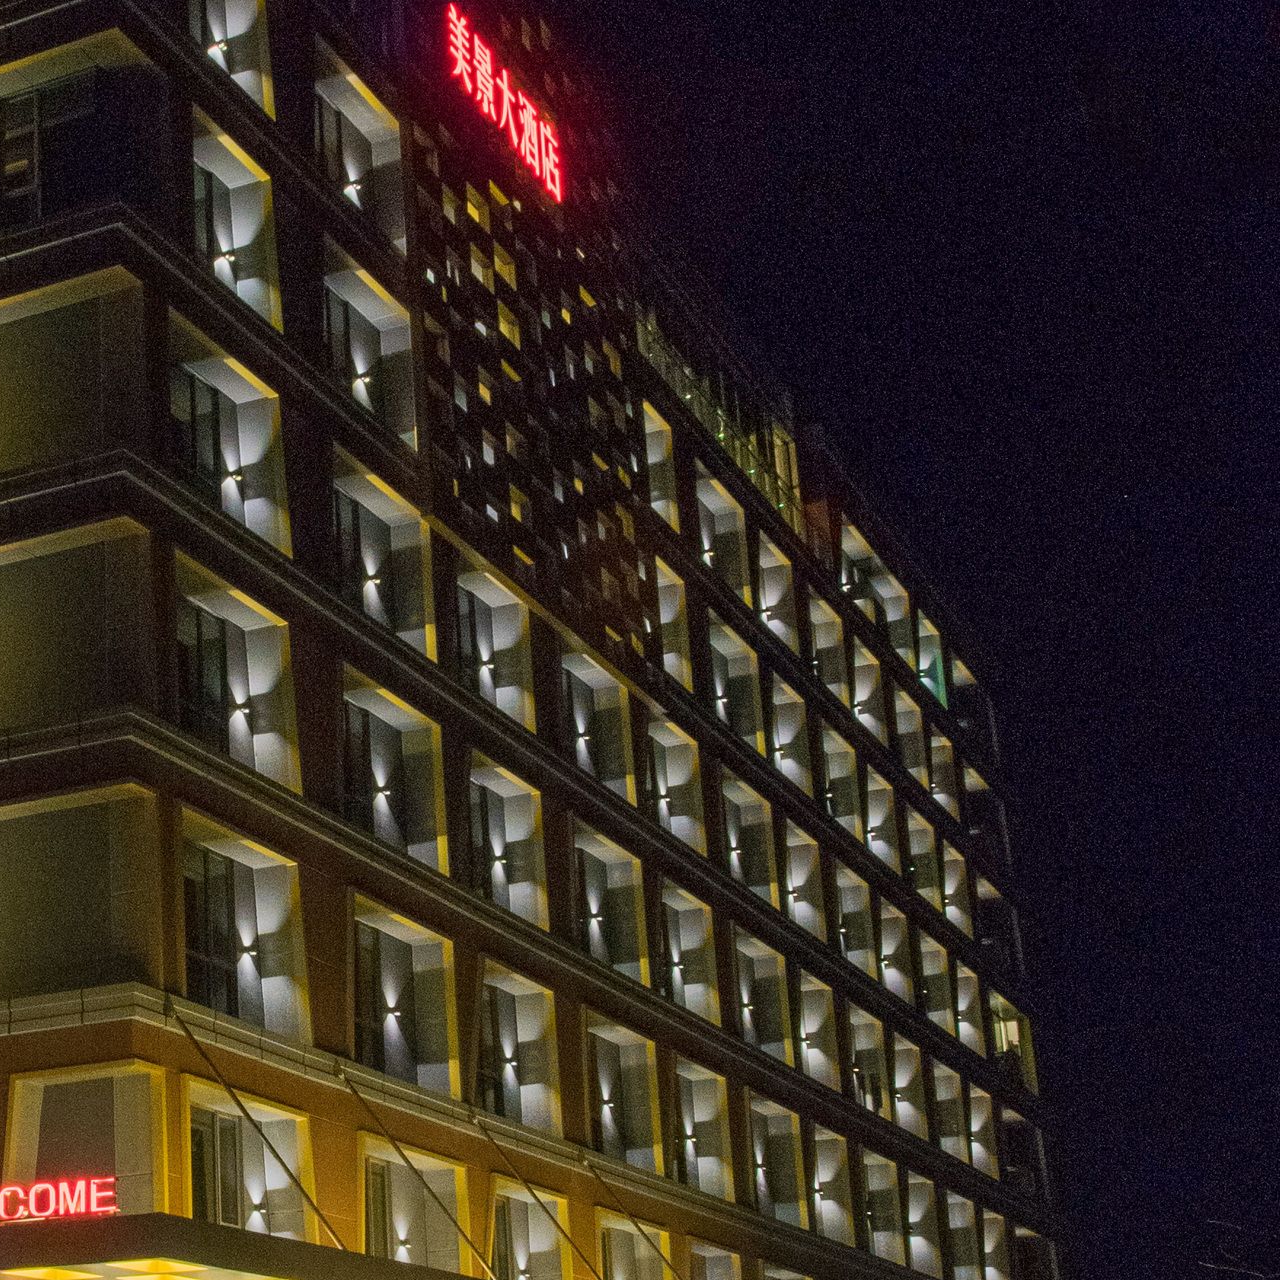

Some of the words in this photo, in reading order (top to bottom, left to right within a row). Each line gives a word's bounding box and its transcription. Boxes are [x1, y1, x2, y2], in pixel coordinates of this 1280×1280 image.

[448, 2, 562, 202] 美景大酒店
